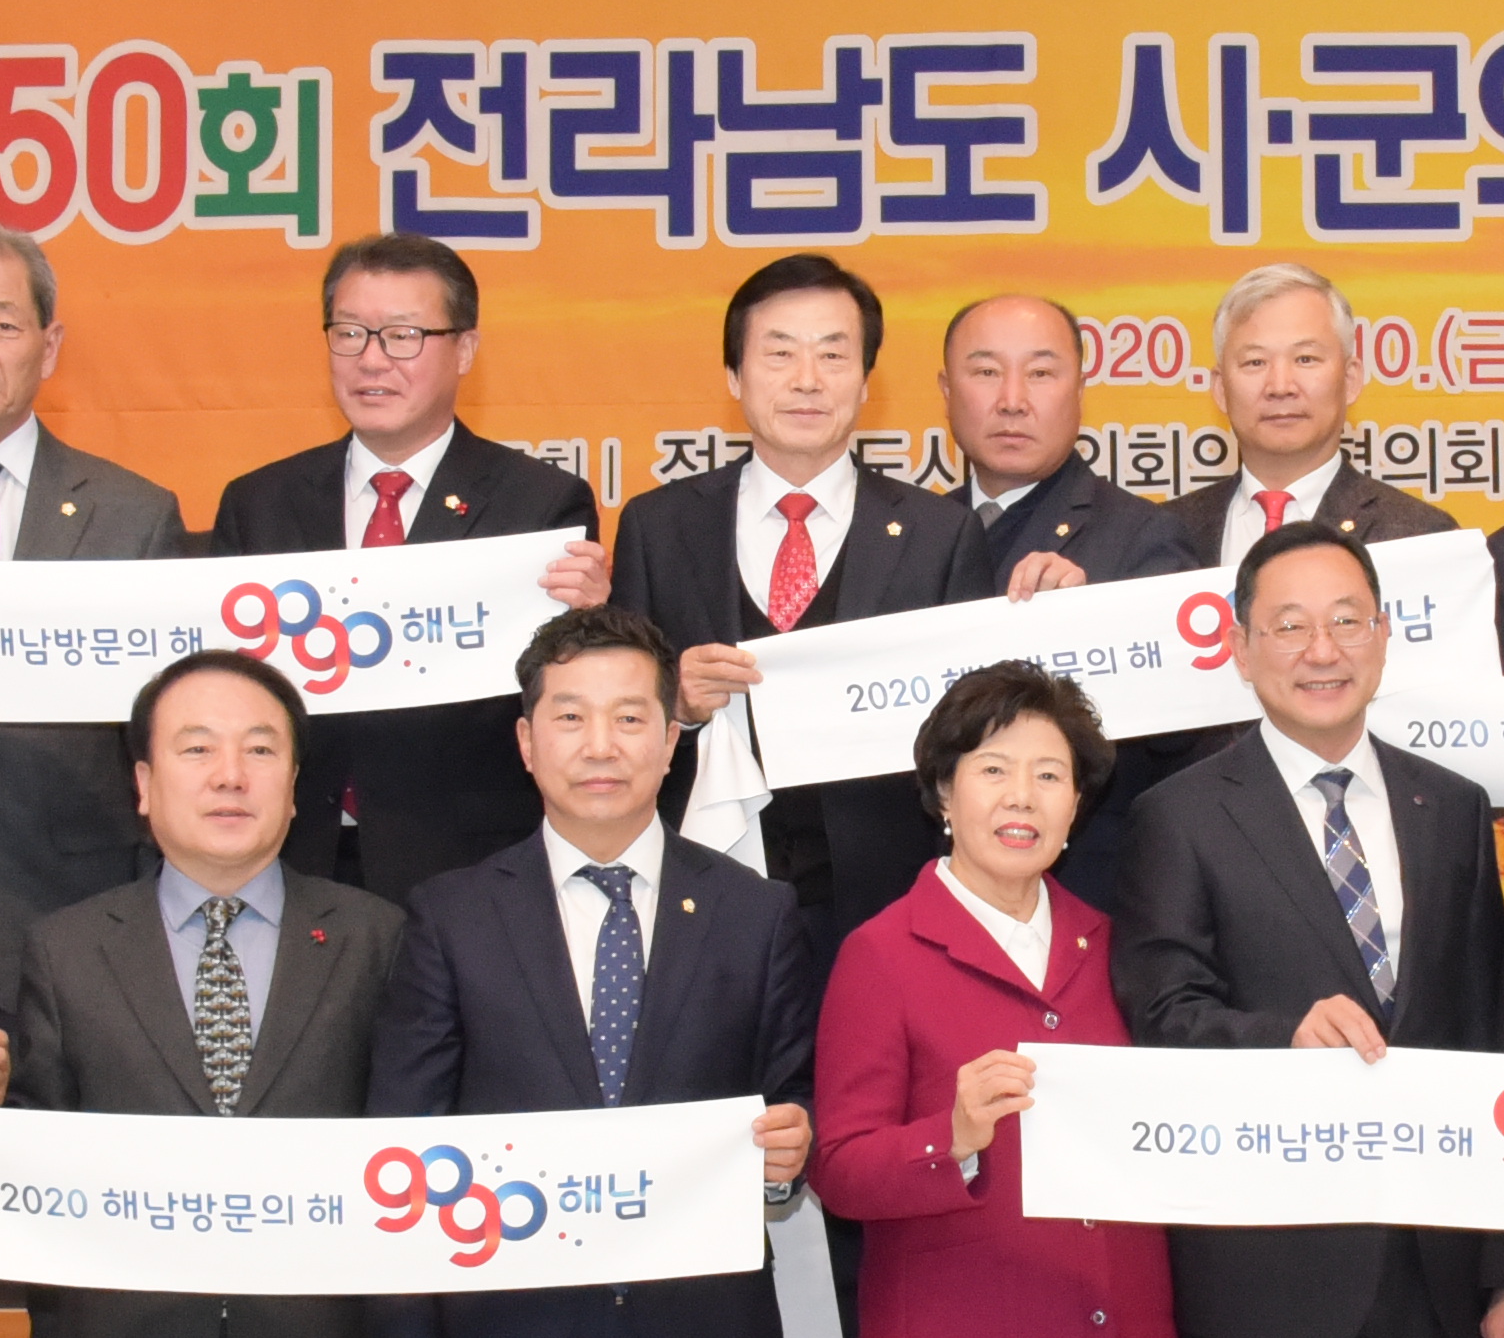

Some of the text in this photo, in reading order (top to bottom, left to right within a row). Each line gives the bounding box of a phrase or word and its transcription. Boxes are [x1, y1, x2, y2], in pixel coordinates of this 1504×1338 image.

[381, 44, 1037, 238] 전라남도
[1080, 322, 1203, 384] 020.
[169, 626, 203, 655] 해
[401, 601, 490, 649] 해남
[846, 675, 931, 712] 2020
[1127, 641, 1162, 669] 해
[1407, 719, 1489, 748] 2020
[1132, 1121, 1221, 1156] 2020
[1235, 1120, 1425, 1162] 해남방문의
[1437, 1123, 1474, 1158] 해
[1, 1183, 88, 1220] 2020
[101, 1188, 294, 1233] 해남방문의
[308, 1192, 344, 1225] 해
[558, 1170, 653, 1220] 해남
